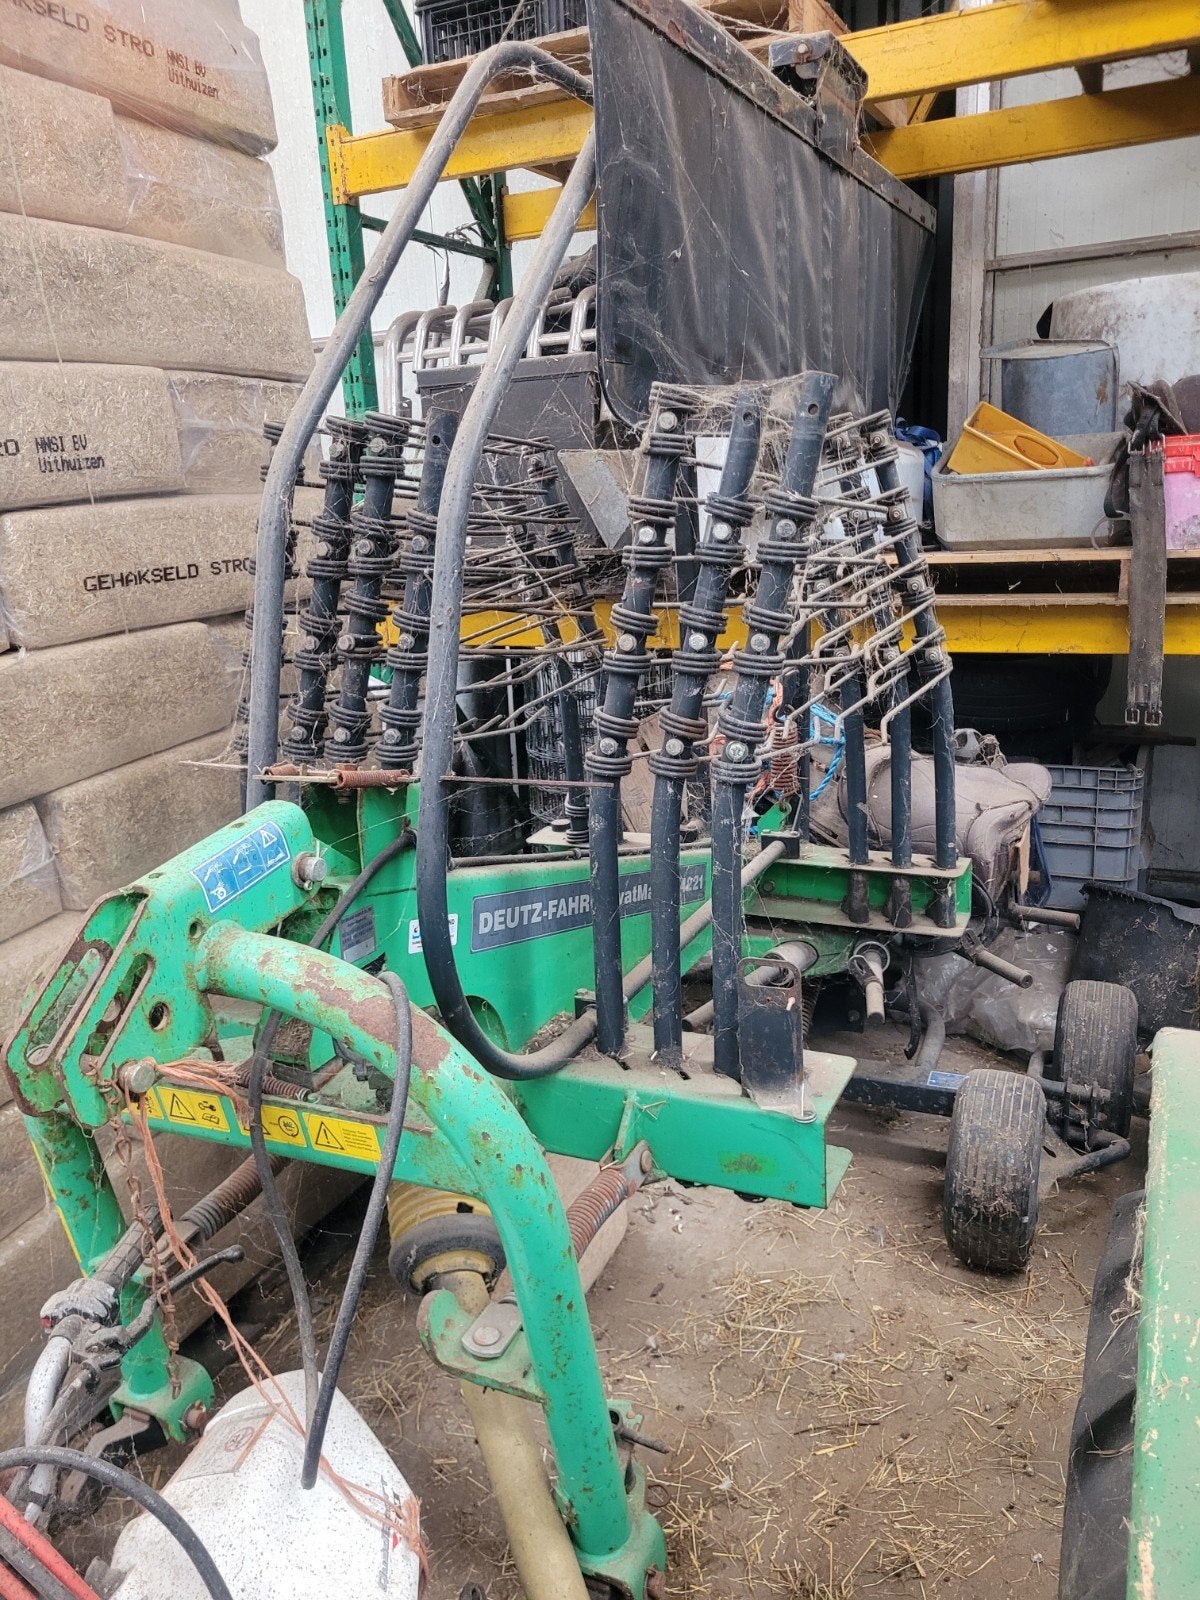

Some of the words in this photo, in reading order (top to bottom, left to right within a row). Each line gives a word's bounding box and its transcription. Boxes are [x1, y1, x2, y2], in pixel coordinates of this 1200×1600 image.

[103, 23, 155, 57] STRO
[167, 66, 219, 100] Uithuizen
[37, 455, 105, 474] Uithuizen
[83, 563, 200, 592] GEHAKSELD
[478, 893, 591, 935] DEUTZ-FAHR
